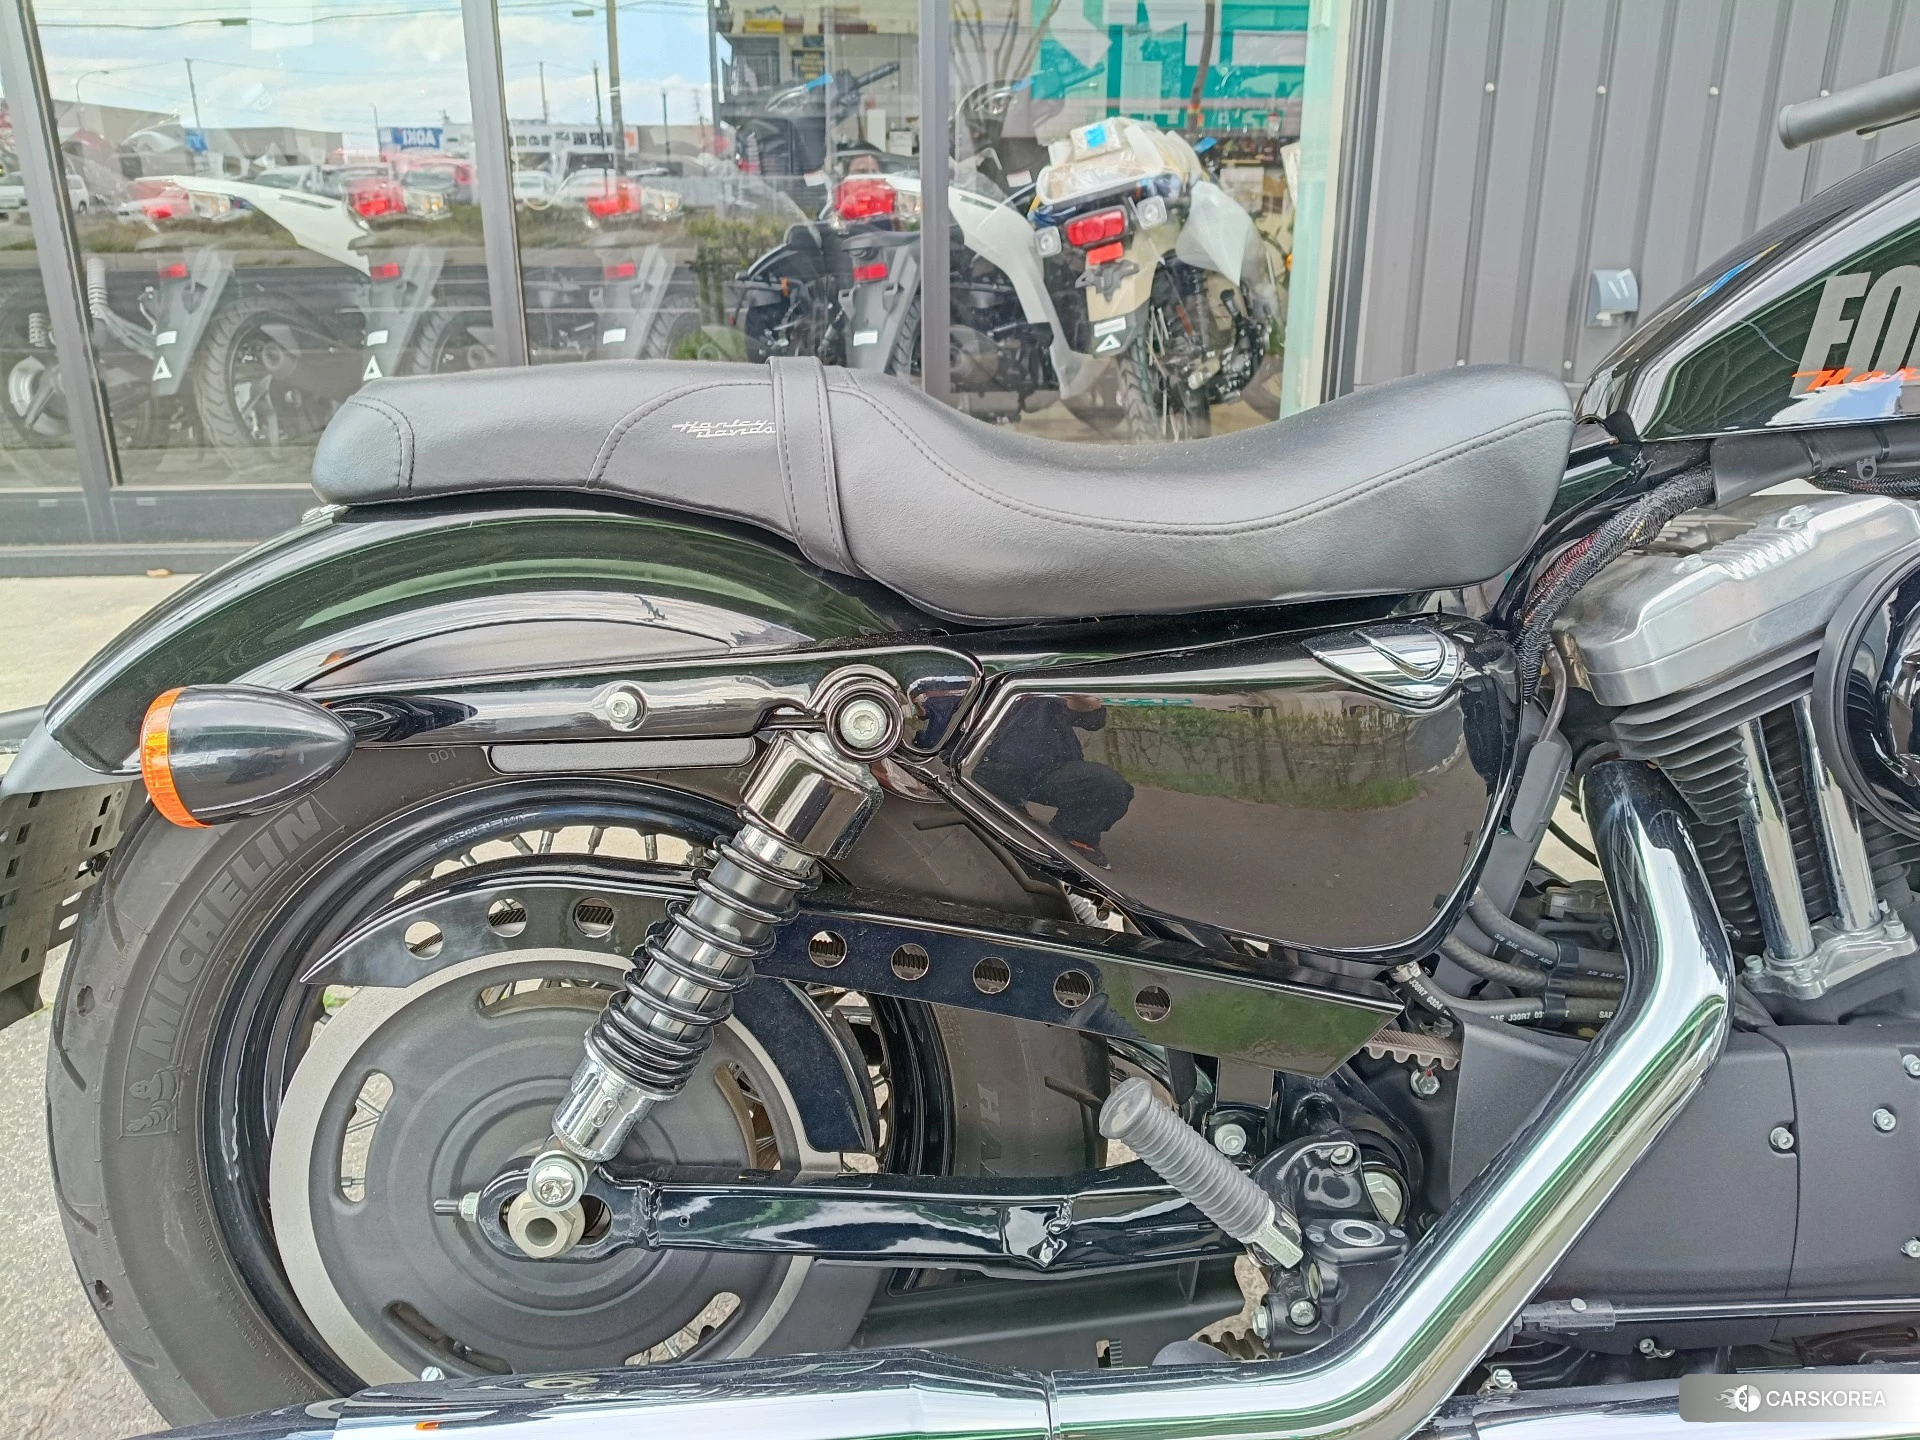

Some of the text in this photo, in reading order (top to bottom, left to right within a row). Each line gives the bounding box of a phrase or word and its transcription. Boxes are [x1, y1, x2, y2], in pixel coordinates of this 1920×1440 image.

[1788, 264, 1920, 399] FO
[428, 747, 457, 764] DOT
[136, 800, 323, 1059] MICHELIN
[1408, 977, 1444, 1011] J30R7 0324
[1508, 1011, 1532, 1022] J30R7
[186, 1157, 220, 1263] MADE IN THAILAND
